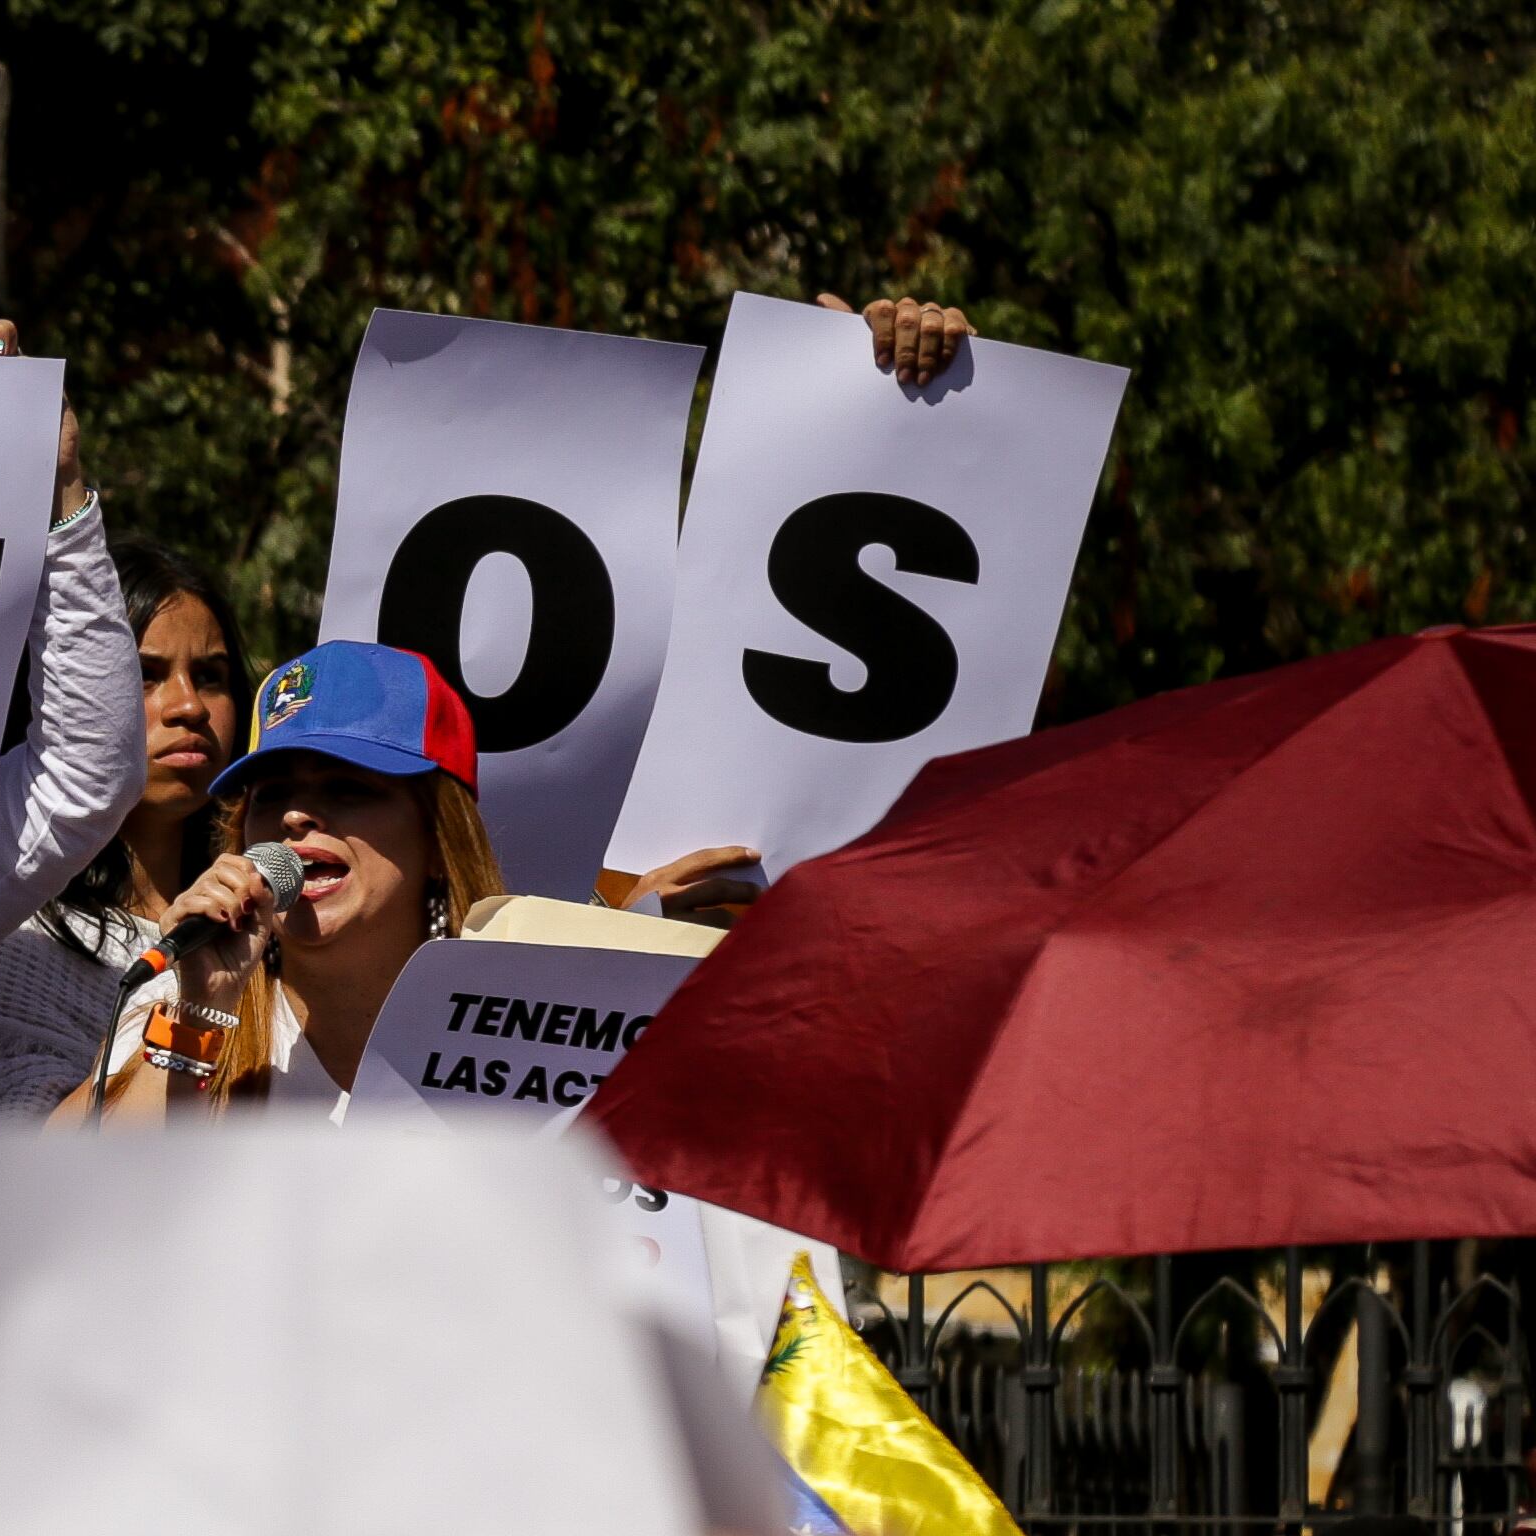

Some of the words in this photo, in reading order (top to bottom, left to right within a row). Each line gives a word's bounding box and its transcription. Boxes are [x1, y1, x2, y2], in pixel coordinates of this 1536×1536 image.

[377, 495, 615, 753] O
[742, 492, 980, 743] S
[421, 1051, 511, 1097] LAS
[447, 993, 657, 1053] TENEM
